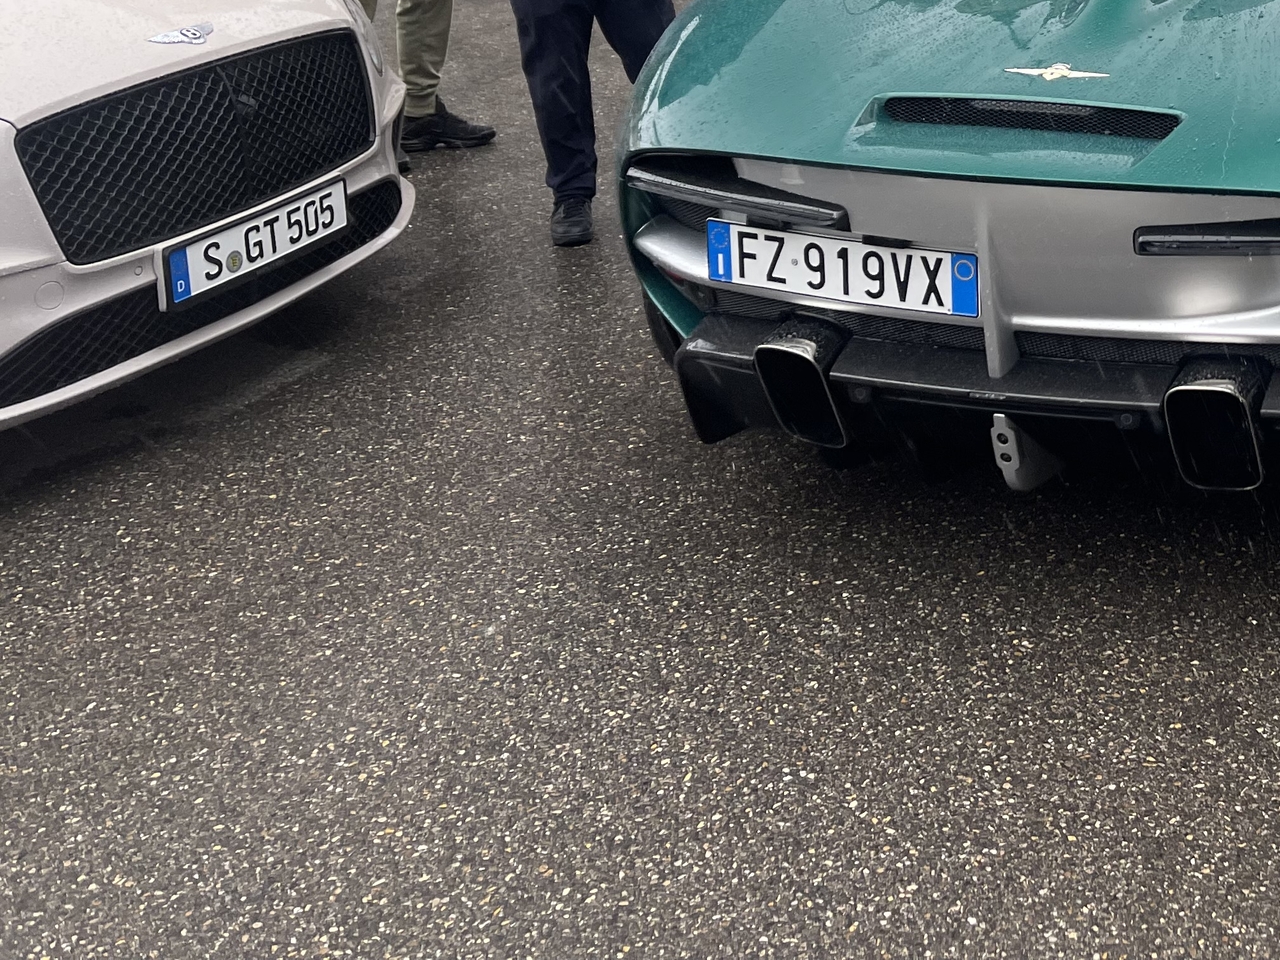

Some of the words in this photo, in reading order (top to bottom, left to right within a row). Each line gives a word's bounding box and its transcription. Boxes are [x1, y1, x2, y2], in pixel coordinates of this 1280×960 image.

[203, 241, 223, 281] S
[244, 215, 280, 263] GT
[286, 191, 335, 244] 505
[737, 230, 787, 284] FZ
[177, 279, 186, 293] D
